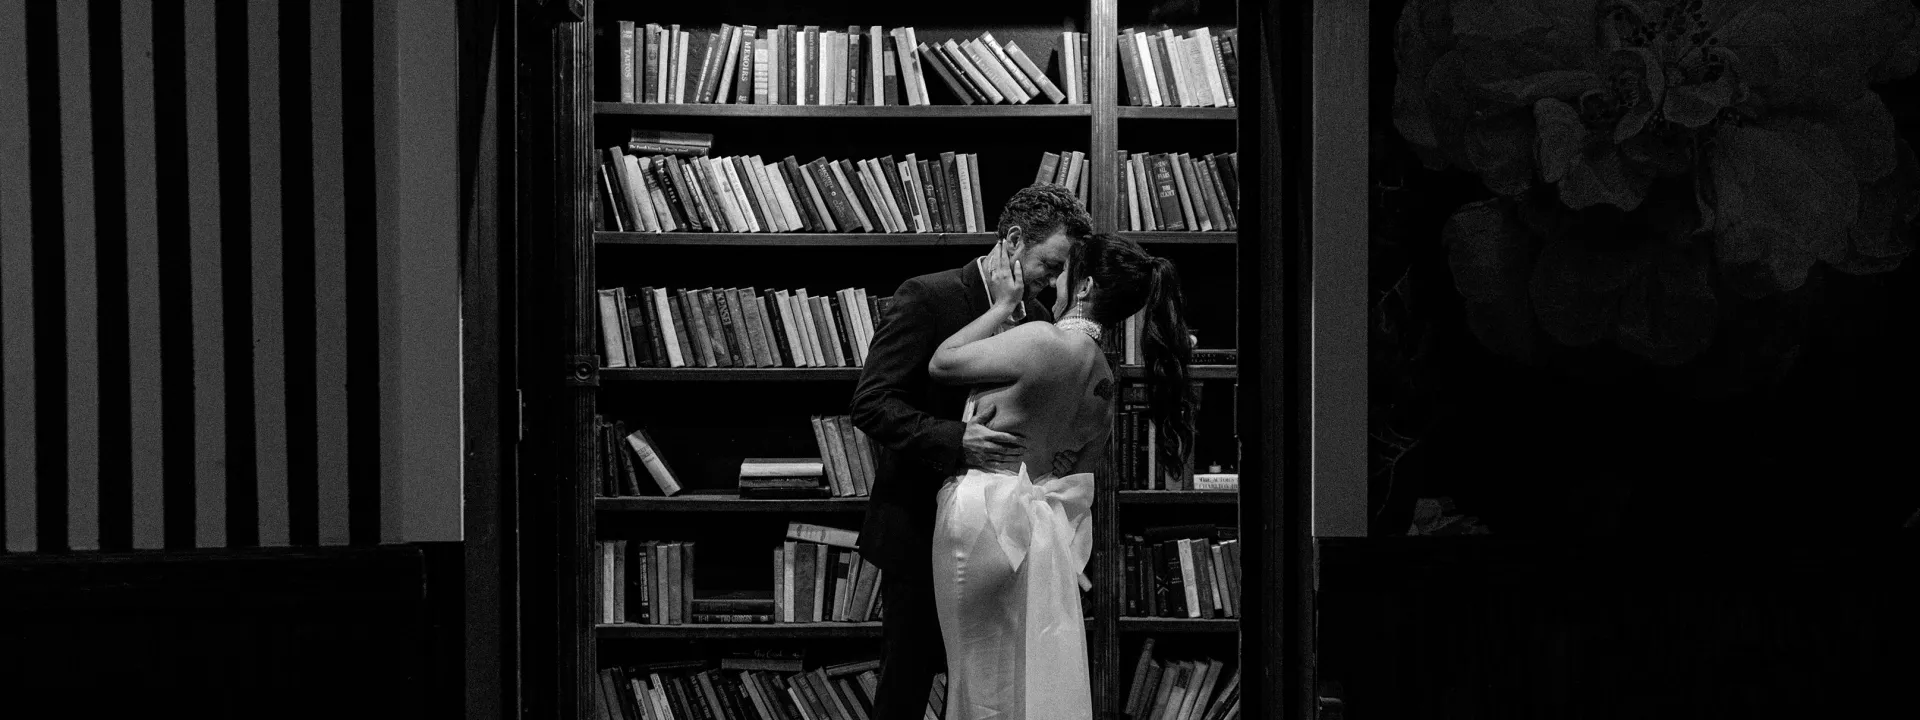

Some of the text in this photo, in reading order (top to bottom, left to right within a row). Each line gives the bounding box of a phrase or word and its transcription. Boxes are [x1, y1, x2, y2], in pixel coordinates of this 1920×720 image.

[623, 48, 632, 77] TALTOS
[741, 41, 752, 81] MEMOIRS
[817, 168, 829, 187] ORDERS
[820, 164, 834, 189] EXECUTIVE
[833, 199, 845, 217] CLANCY
